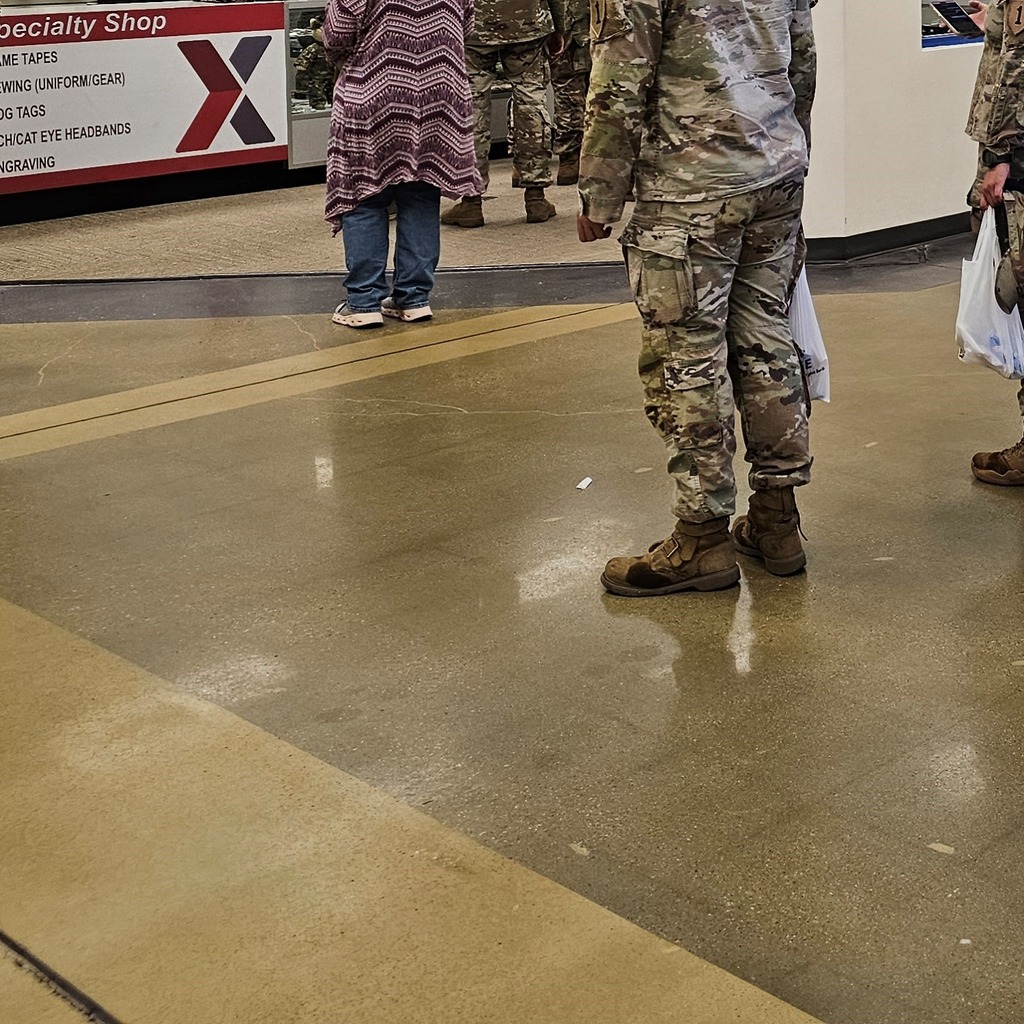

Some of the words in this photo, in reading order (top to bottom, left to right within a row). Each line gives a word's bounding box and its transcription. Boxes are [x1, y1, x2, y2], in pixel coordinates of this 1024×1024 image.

[1014, 6, 1024, 25] 1
[0, 15, 97, 39] pecialty
[104, 12, 167, 35] Shop
[0, 53, 19, 67] ME
[22, 51, 58, 65] TAPES
[0, 79, 32, 94] WING
[35, 72, 125, 94] (UNIFORM/GEAR)
[0, 108, 13, 121] OG
[16, 104, 46, 119] TAGS
[0, 131, 37, 147] CH/CAT
[41, 129, 62, 143] EYE
[65, 122, 131, 141] HEADBANDS
[0, 156, 55, 174] NGRAVING
